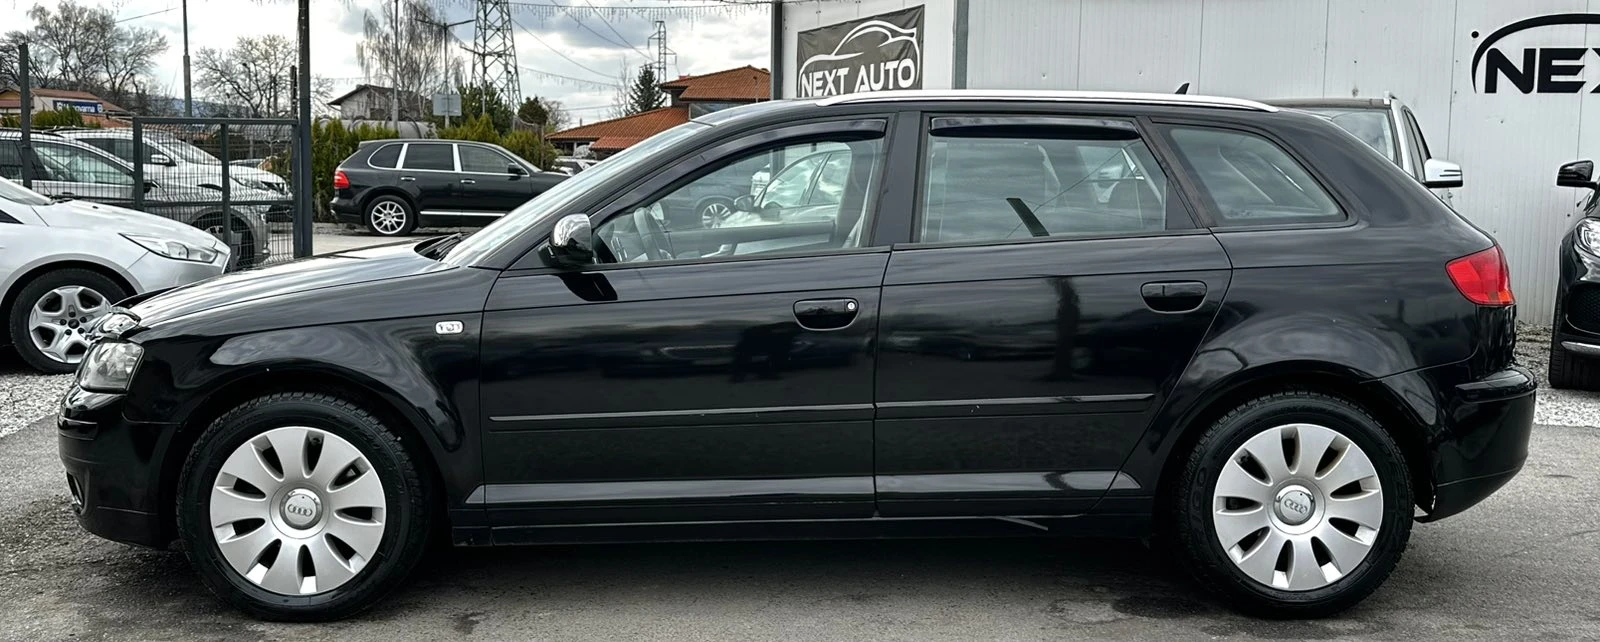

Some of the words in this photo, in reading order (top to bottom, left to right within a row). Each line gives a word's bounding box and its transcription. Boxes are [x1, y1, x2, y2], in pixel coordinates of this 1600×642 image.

[801, 68, 849, 98] NEXT
[854, 58, 915, 93] AUTO
[1484, 47, 1600, 94] NE
